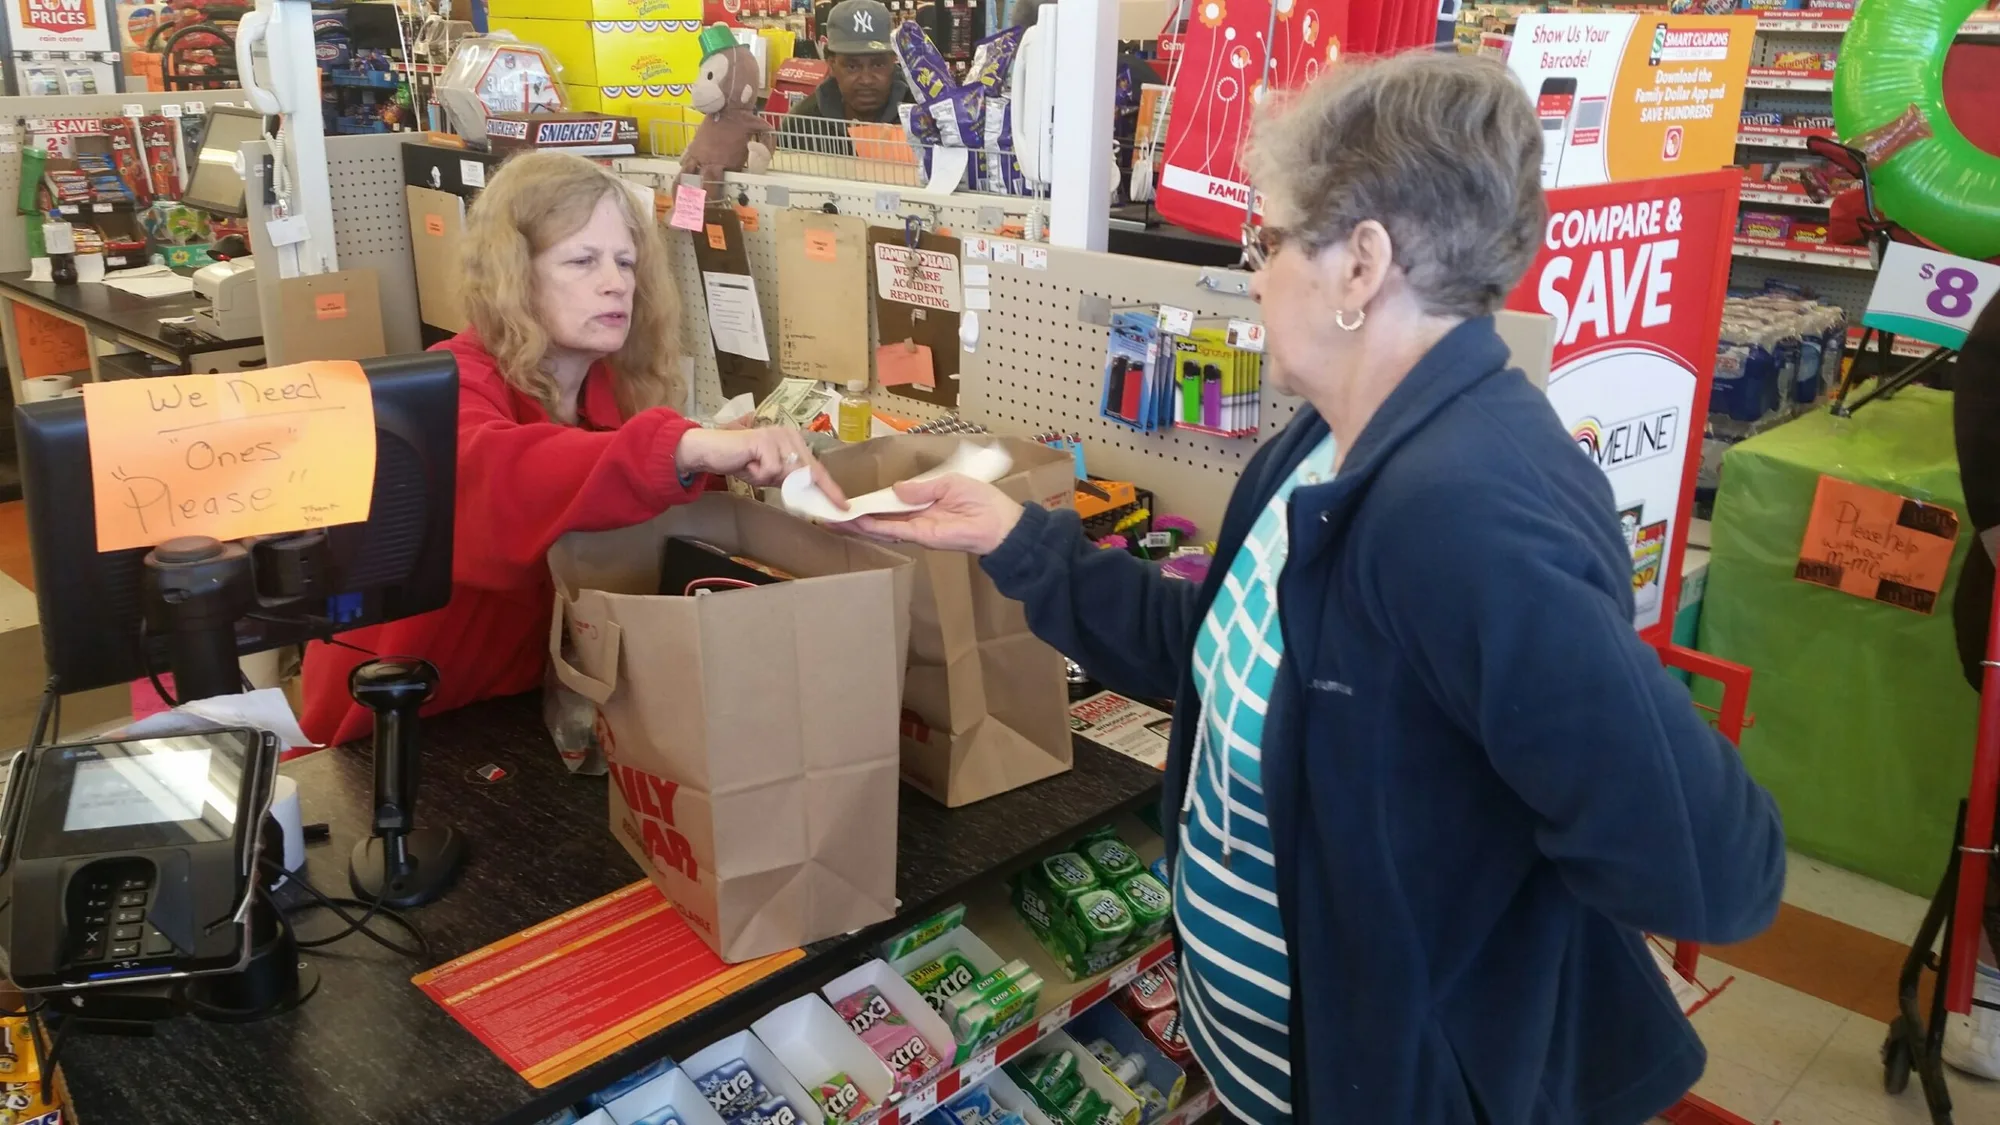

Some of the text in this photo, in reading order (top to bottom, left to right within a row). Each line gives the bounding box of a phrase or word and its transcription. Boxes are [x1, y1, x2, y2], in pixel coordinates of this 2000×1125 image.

[30, 11, 87, 25] PRICES
[1532, 25, 1611, 44] Show Us Your
[1664, 31, 1730, 47] SMART COUPONS
[1540, 50, 1593, 69] Barcode!
[1655, 67, 1713, 84] Download the
[1634, 83, 1726, 105] Family Dollar App and
[1640, 103, 1714, 122] SAVE HUNDREDS!
[56, 120, 100, 133] SAVE!
[486, 119, 519, 137] SNICKERS
[539, 123, 599, 142] SNICKERS
[602, 121, 614, 134] 2
[46, 137, 59, 151] 2
[1545, 196, 1683, 250] COMPARE &
[893, 265, 910, 276] WE
[889, 289, 950, 309] REPORTING
[1538, 238, 1680, 346] SAVE
[147, 384, 208, 413] We
[1836, 500, 1920, 561] Please help
[920, 961, 942, 979] STICKS
[976, 976, 995, 991] Extra
[990, 990, 1009, 1006] Extra
[886, 1035, 927, 1072] xtra
[706, 1068, 755, 1111] xtra
